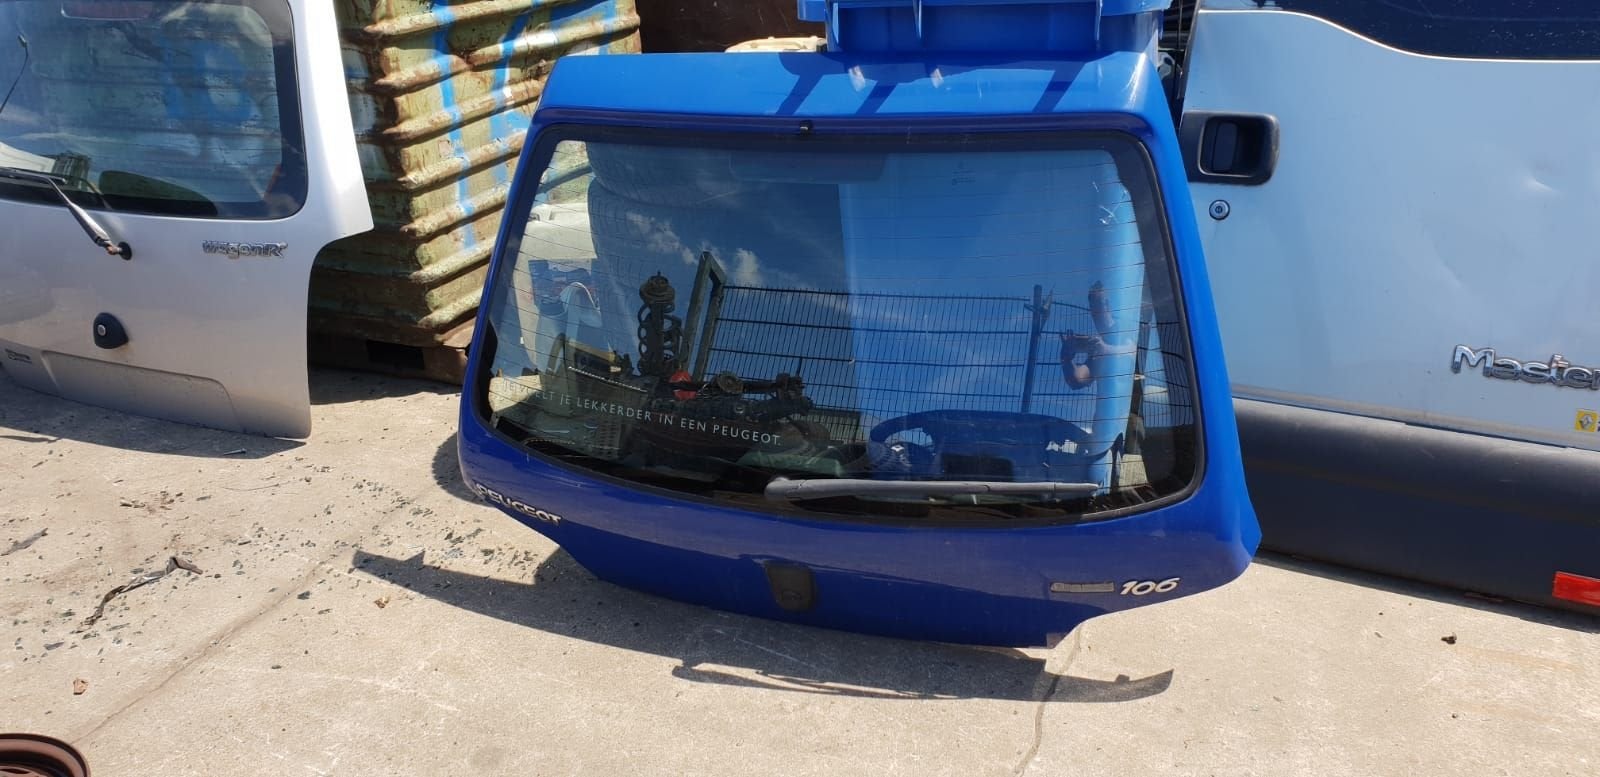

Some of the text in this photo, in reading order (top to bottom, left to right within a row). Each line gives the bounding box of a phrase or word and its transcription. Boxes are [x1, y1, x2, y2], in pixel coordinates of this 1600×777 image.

[559, 393, 571, 406] JE
[576, 396, 652, 422] LEKKERDER
[659, 413, 674, 426] IN
[680, 417, 707, 433] EEN
[475, 481, 562, 527] PEUGEOT
[1119, 576, 1180, 596] 106
